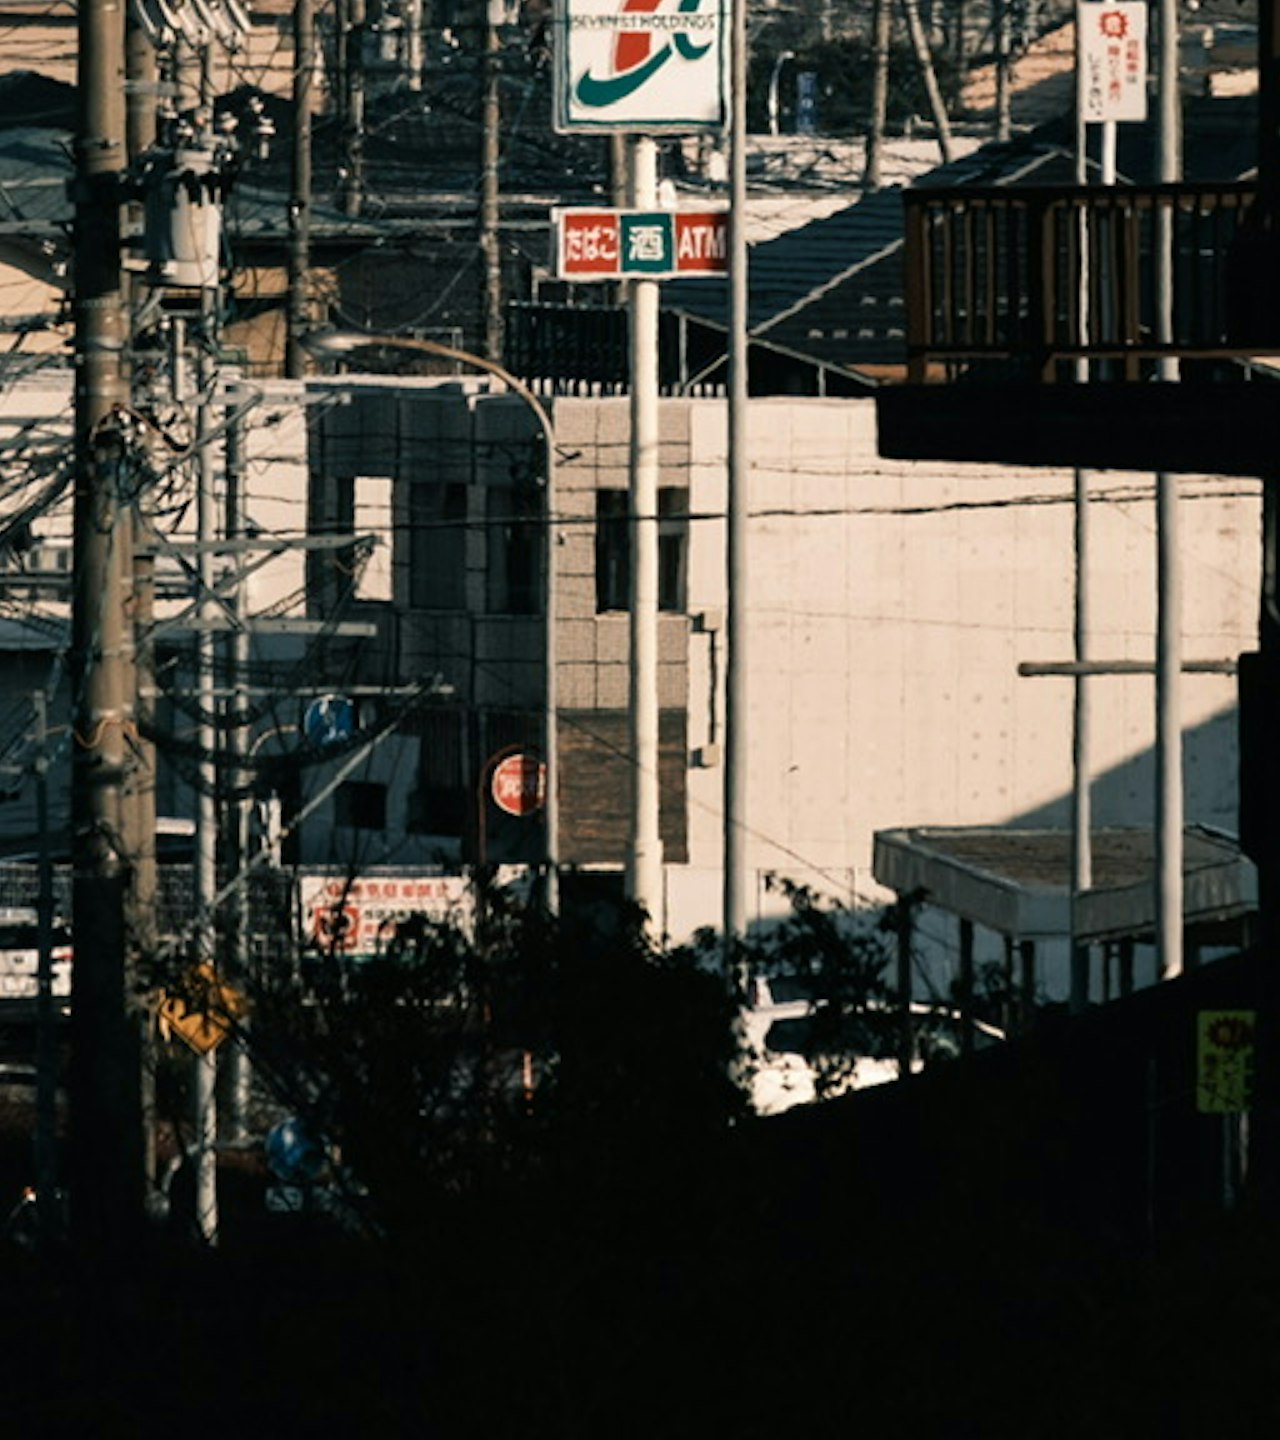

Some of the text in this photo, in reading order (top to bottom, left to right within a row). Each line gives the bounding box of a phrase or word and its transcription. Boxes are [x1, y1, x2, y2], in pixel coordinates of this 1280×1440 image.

[640, 14, 715, 30] HOLDINGS
[566, 225, 726, 261] たばこ 酒 ATM
